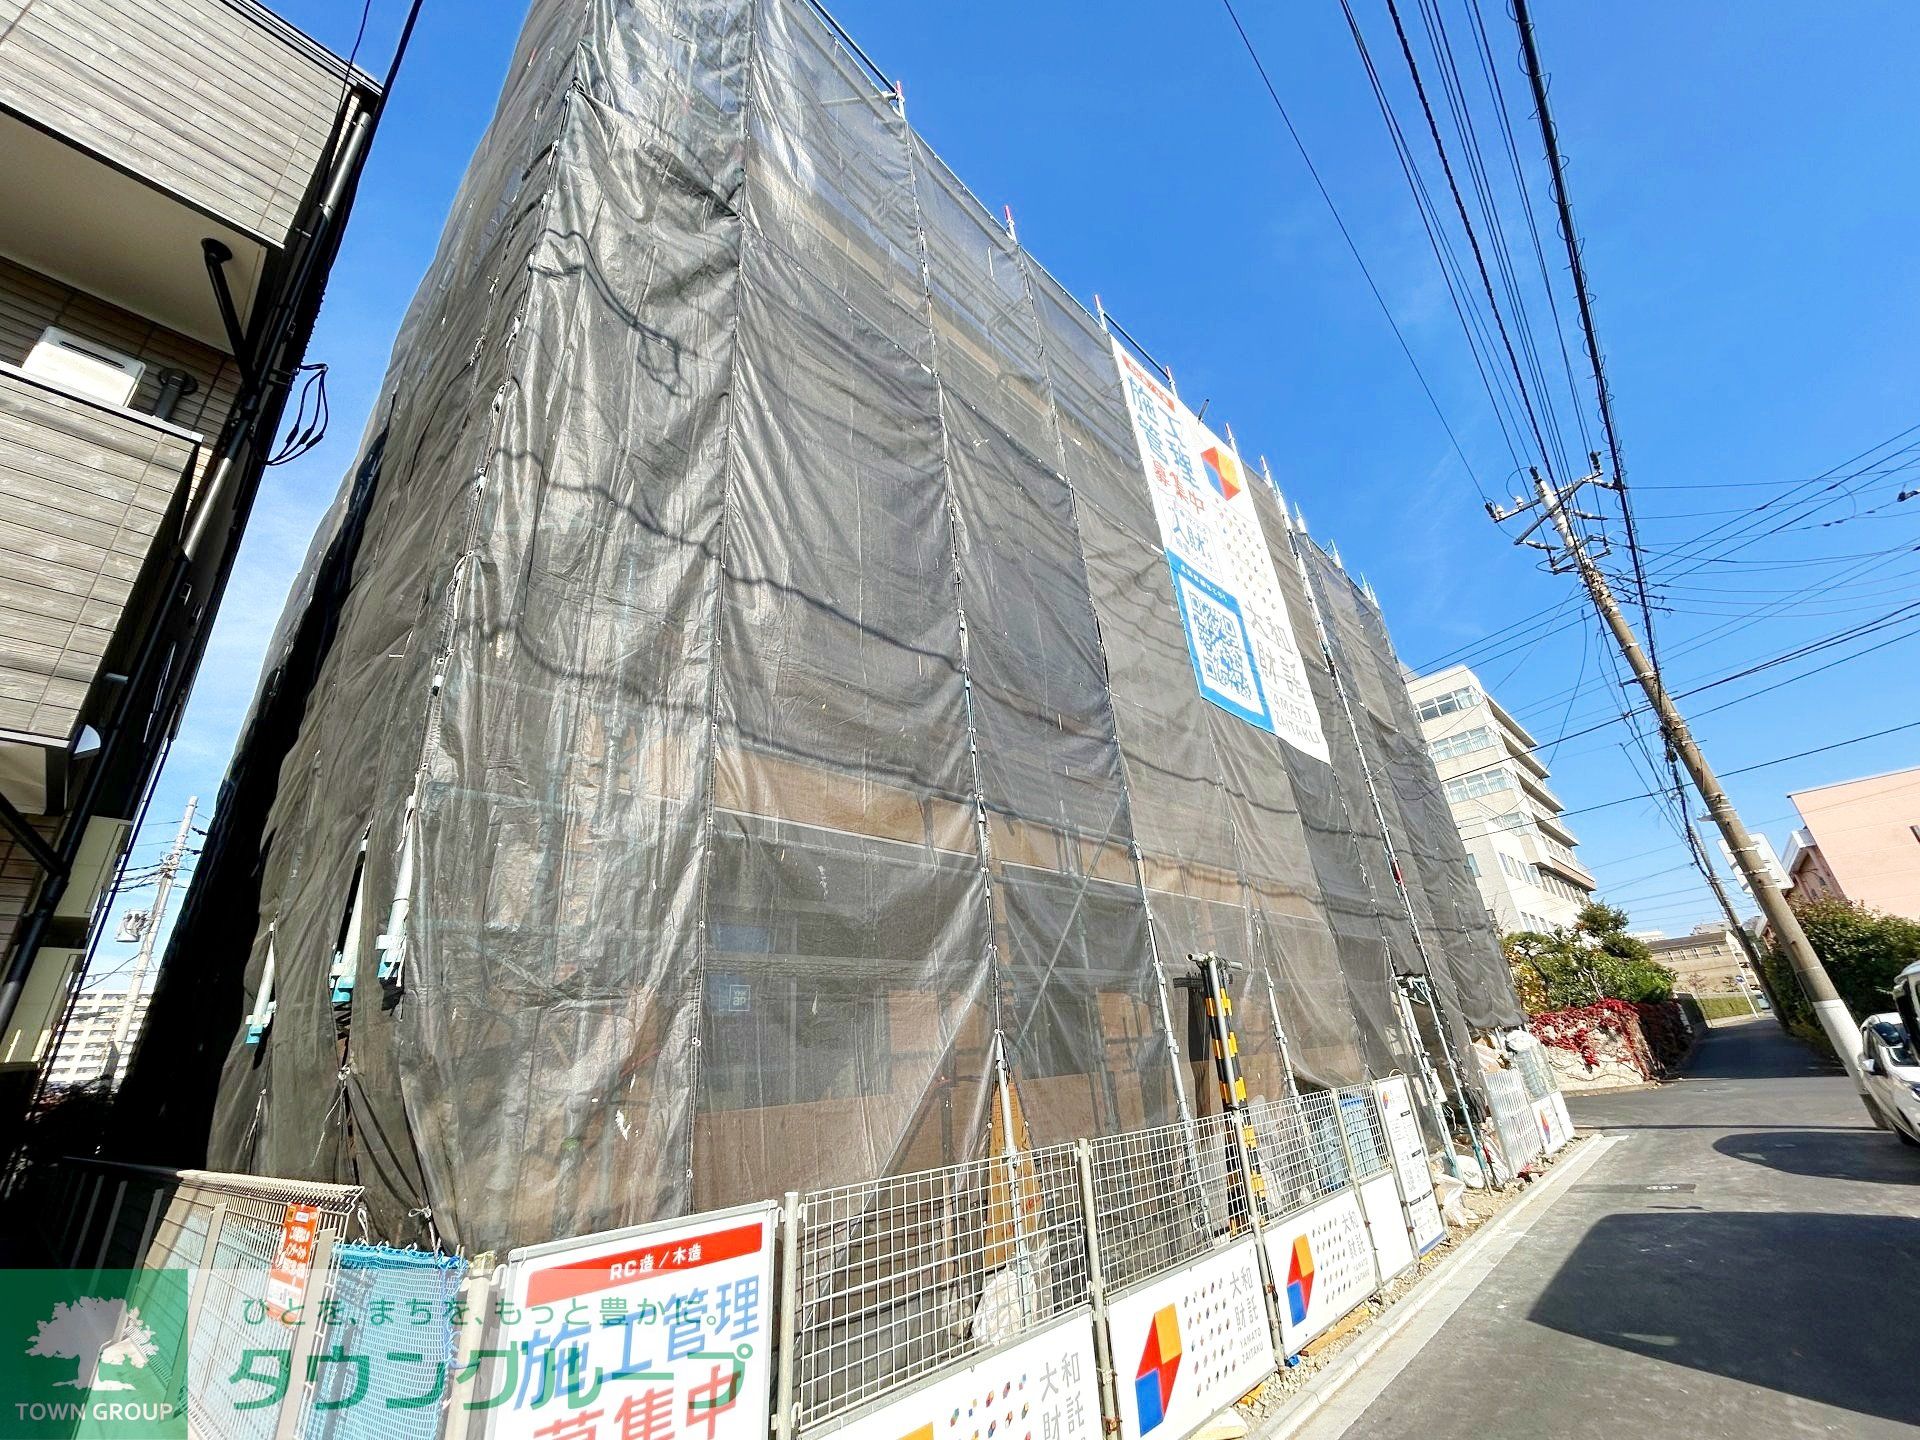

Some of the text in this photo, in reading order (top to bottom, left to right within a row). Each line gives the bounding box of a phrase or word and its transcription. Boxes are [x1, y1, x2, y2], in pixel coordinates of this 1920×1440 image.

[1127, 375, 1187, 449] 施工
[1136, 414, 1200, 490] 管理
[1153, 459, 1205, 514] 募集中
[1244, 600, 1294, 655] 大和
[1256, 639, 1311, 699] 財託
[1229, 1265, 1254, 1300] 大和
[1234, 1294, 1259, 1333] 財託
[513, 1274, 760, 1411] 施工管理
[1040, 1352, 1081, 1402] 大和
[1043, 1390, 1085, 1440] 財託
